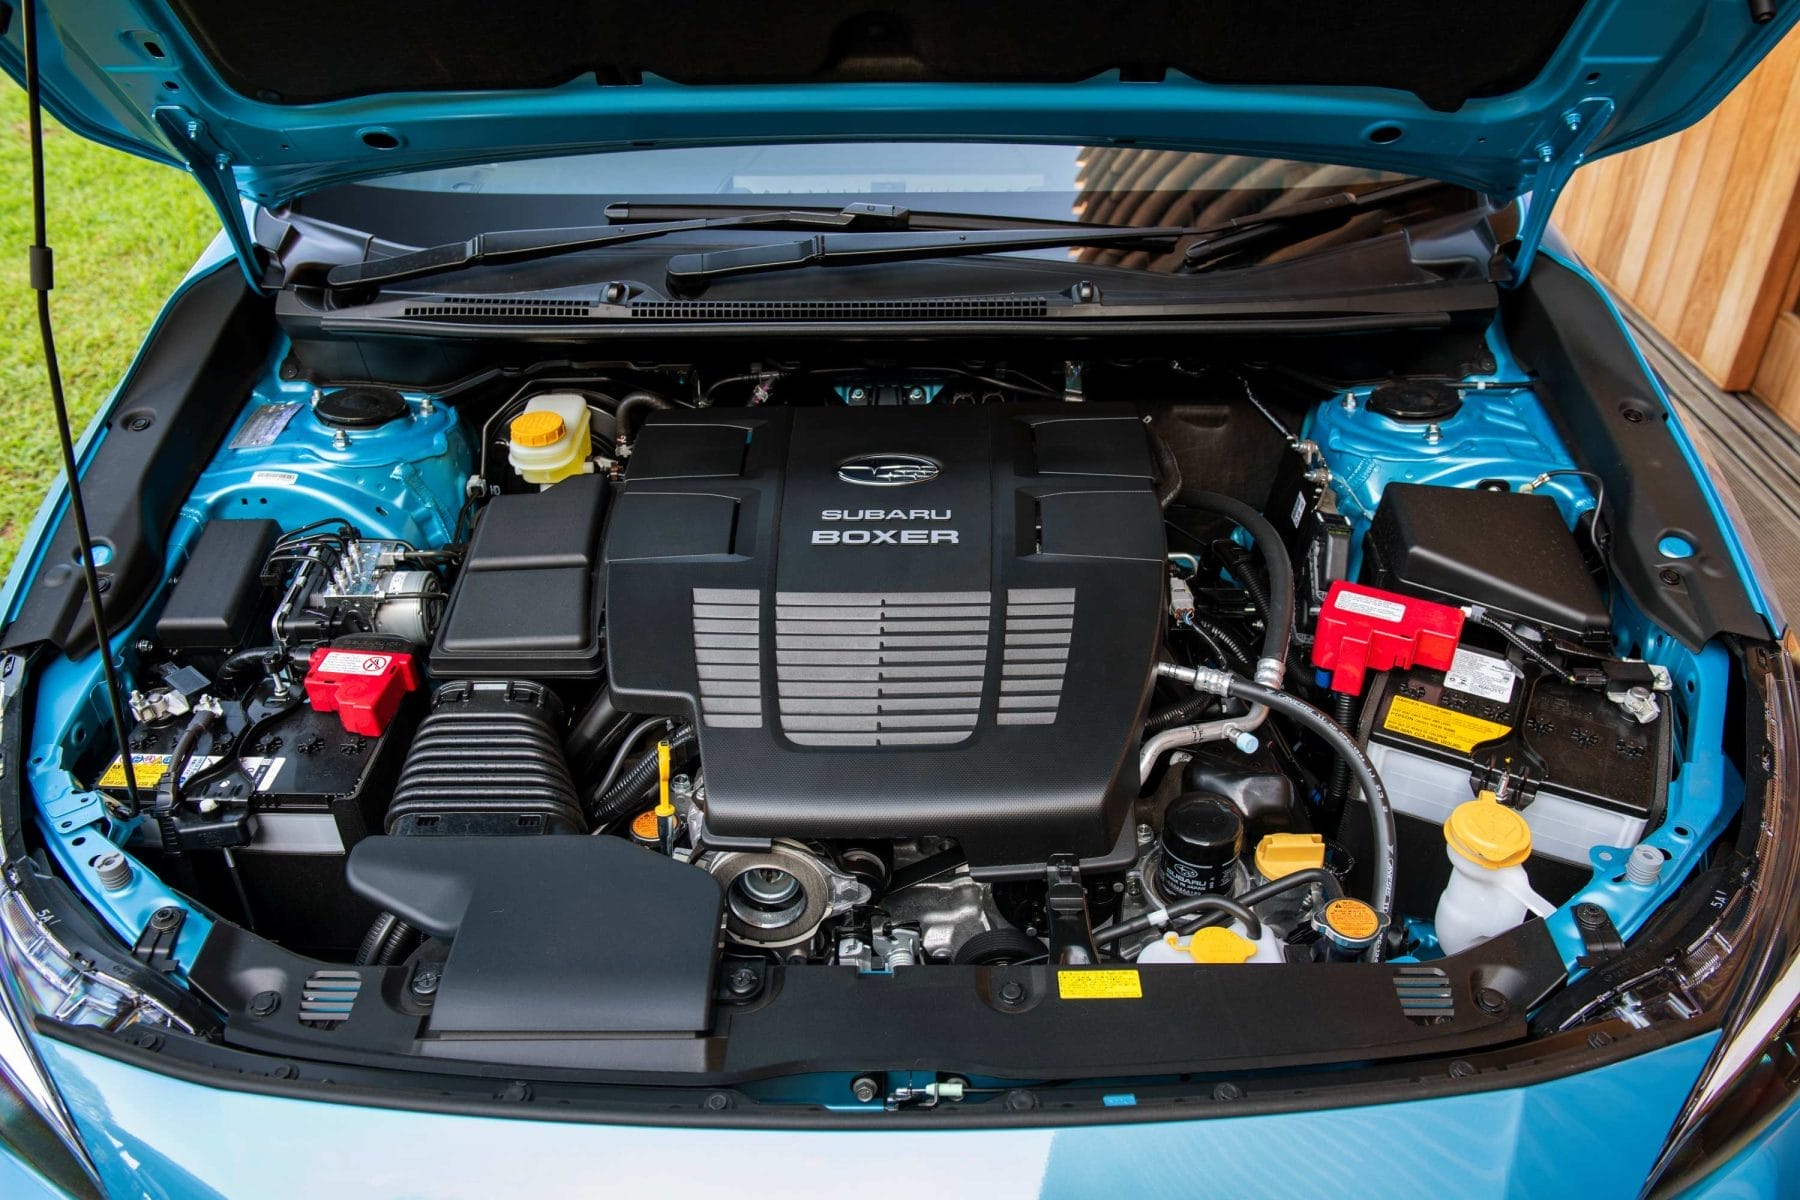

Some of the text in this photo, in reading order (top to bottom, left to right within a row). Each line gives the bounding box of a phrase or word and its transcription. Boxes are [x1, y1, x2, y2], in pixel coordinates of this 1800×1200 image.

[821, 509, 952, 520] SUBARU
[811, 530, 960, 544] BOXER
[1166, 867, 1207, 887] SUBARU
